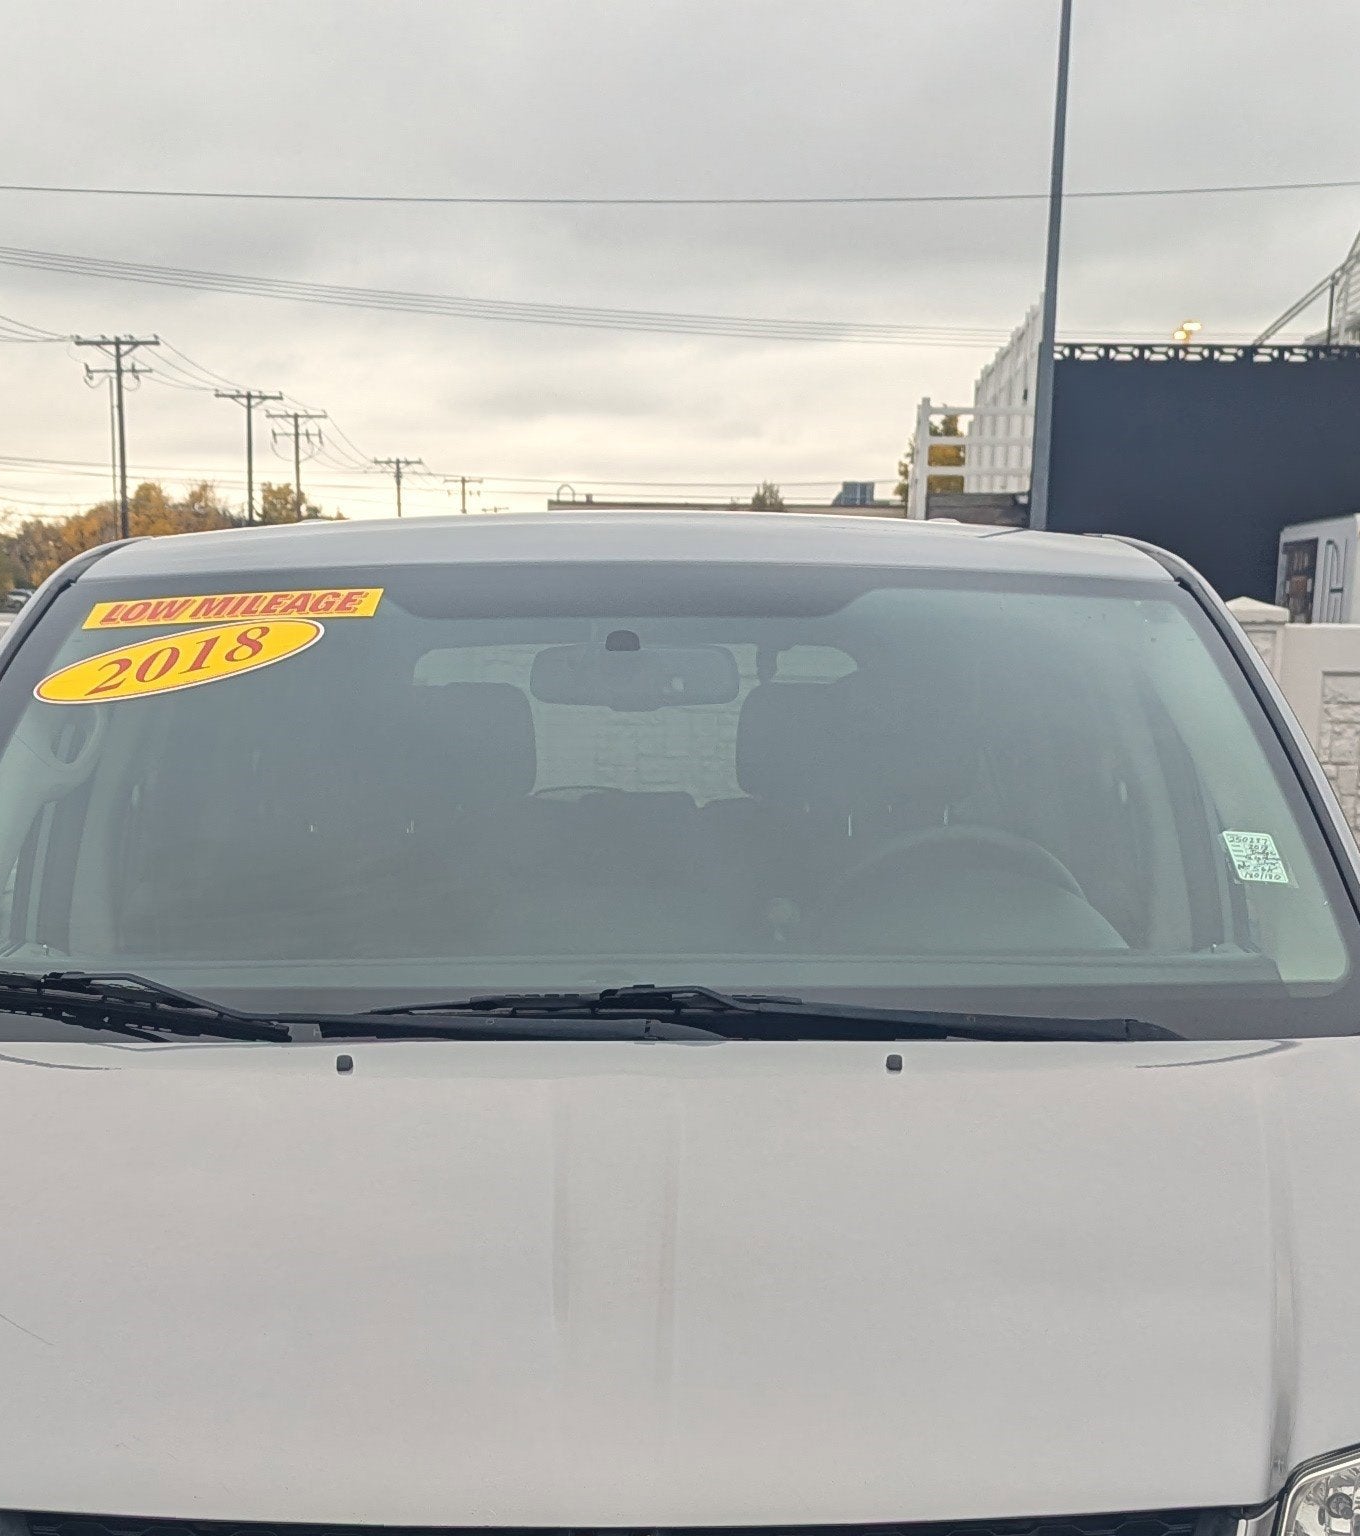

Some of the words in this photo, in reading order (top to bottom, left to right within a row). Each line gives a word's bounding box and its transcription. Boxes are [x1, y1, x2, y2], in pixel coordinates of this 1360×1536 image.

[100, 602, 193, 625] LOW
[189, 591, 369, 619] MILEAGE
[84, 626, 271, 697] 2018
